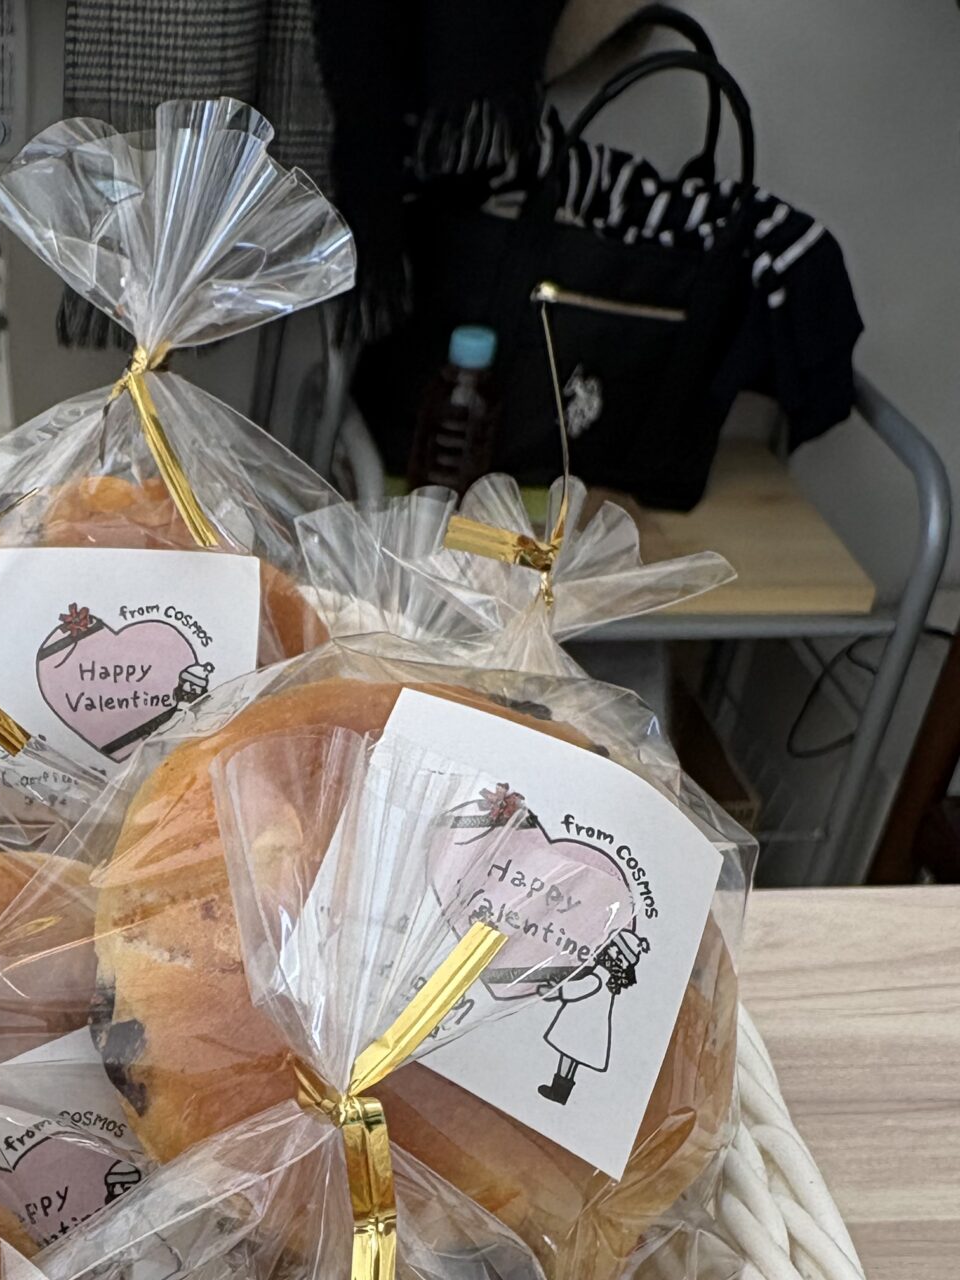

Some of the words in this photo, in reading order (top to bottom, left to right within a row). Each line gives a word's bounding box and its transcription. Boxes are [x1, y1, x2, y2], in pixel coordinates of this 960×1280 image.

[120, 605, 159, 620] from
[164, 606, 213, 648] COSMOS
[79, 660, 152, 683] Happy
[65, 691, 173, 712] Valentine
[561, 814, 614, 844] from
